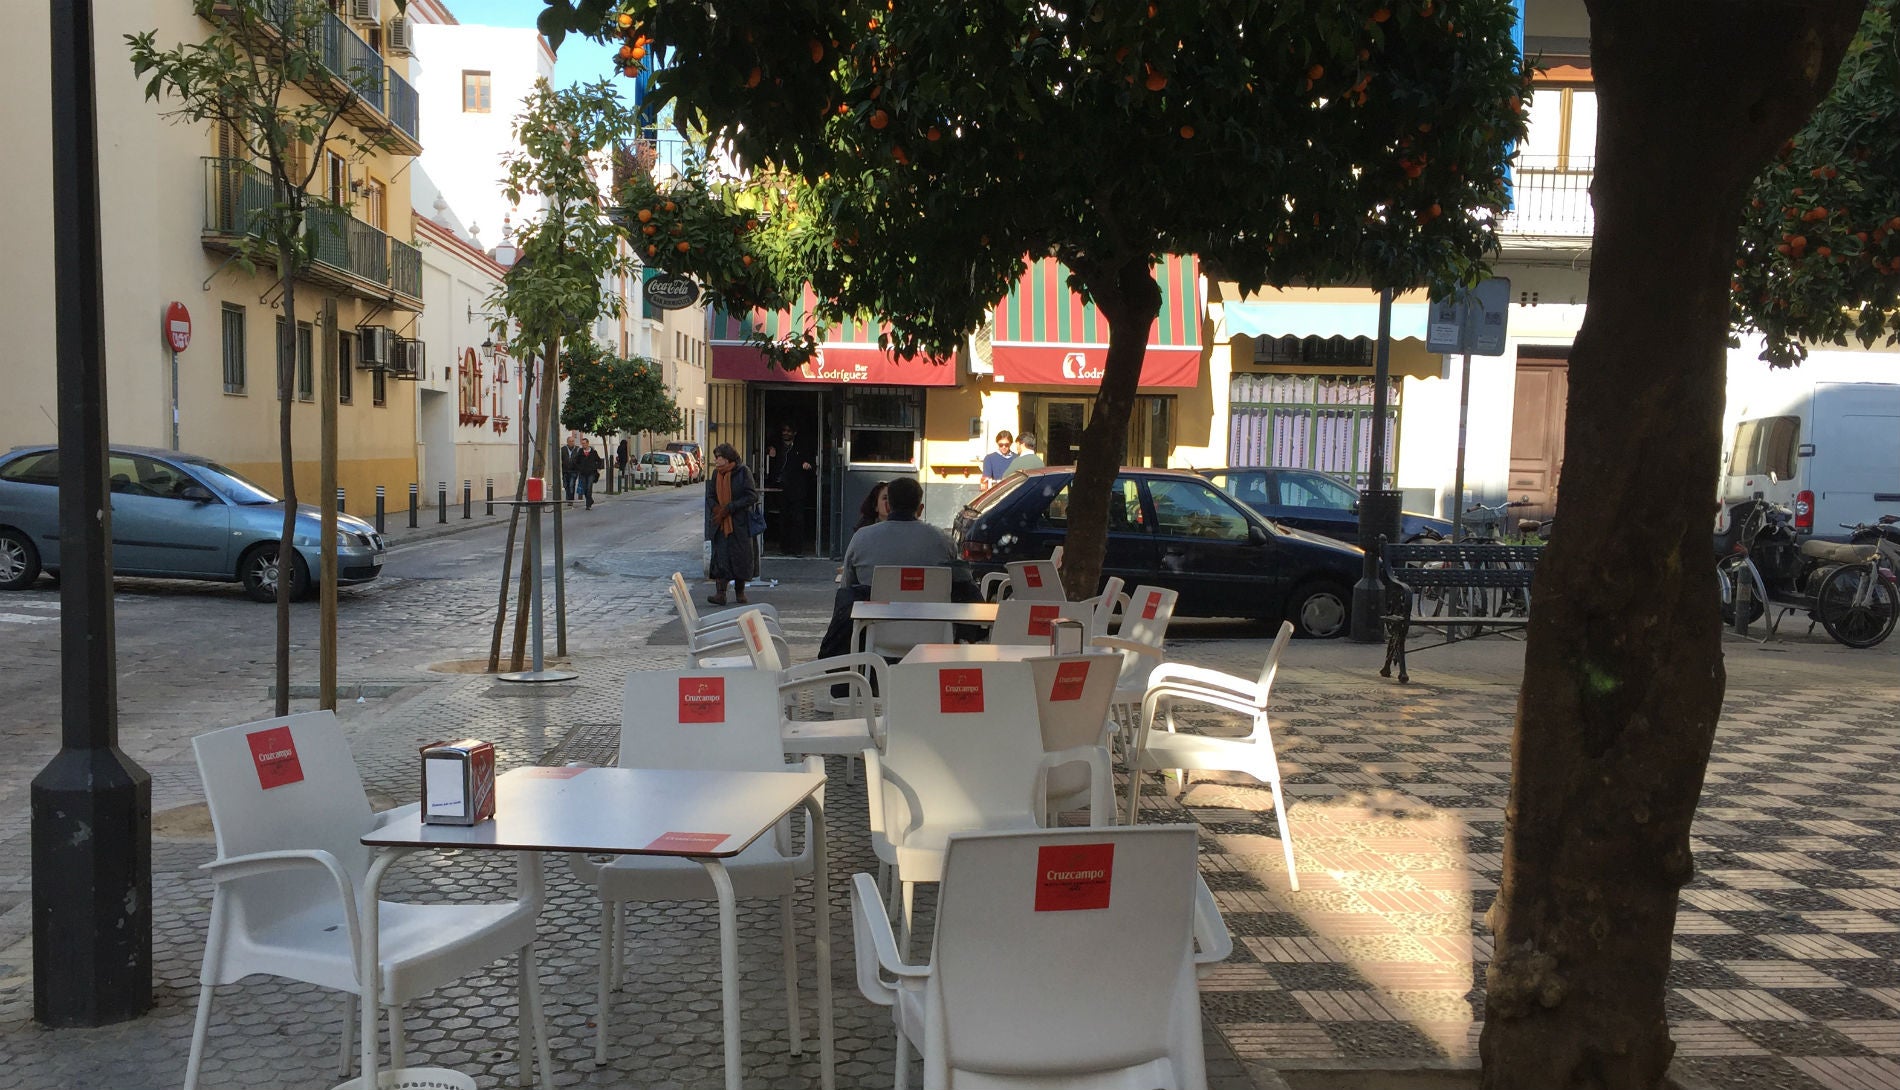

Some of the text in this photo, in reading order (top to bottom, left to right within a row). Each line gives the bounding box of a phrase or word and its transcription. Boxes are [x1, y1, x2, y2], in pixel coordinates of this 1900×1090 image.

[855, 364, 868, 372] Bar
[684, 694, 720, 702] Cruzcampo
[1046, 869, 1104, 880] Cruzcampo
